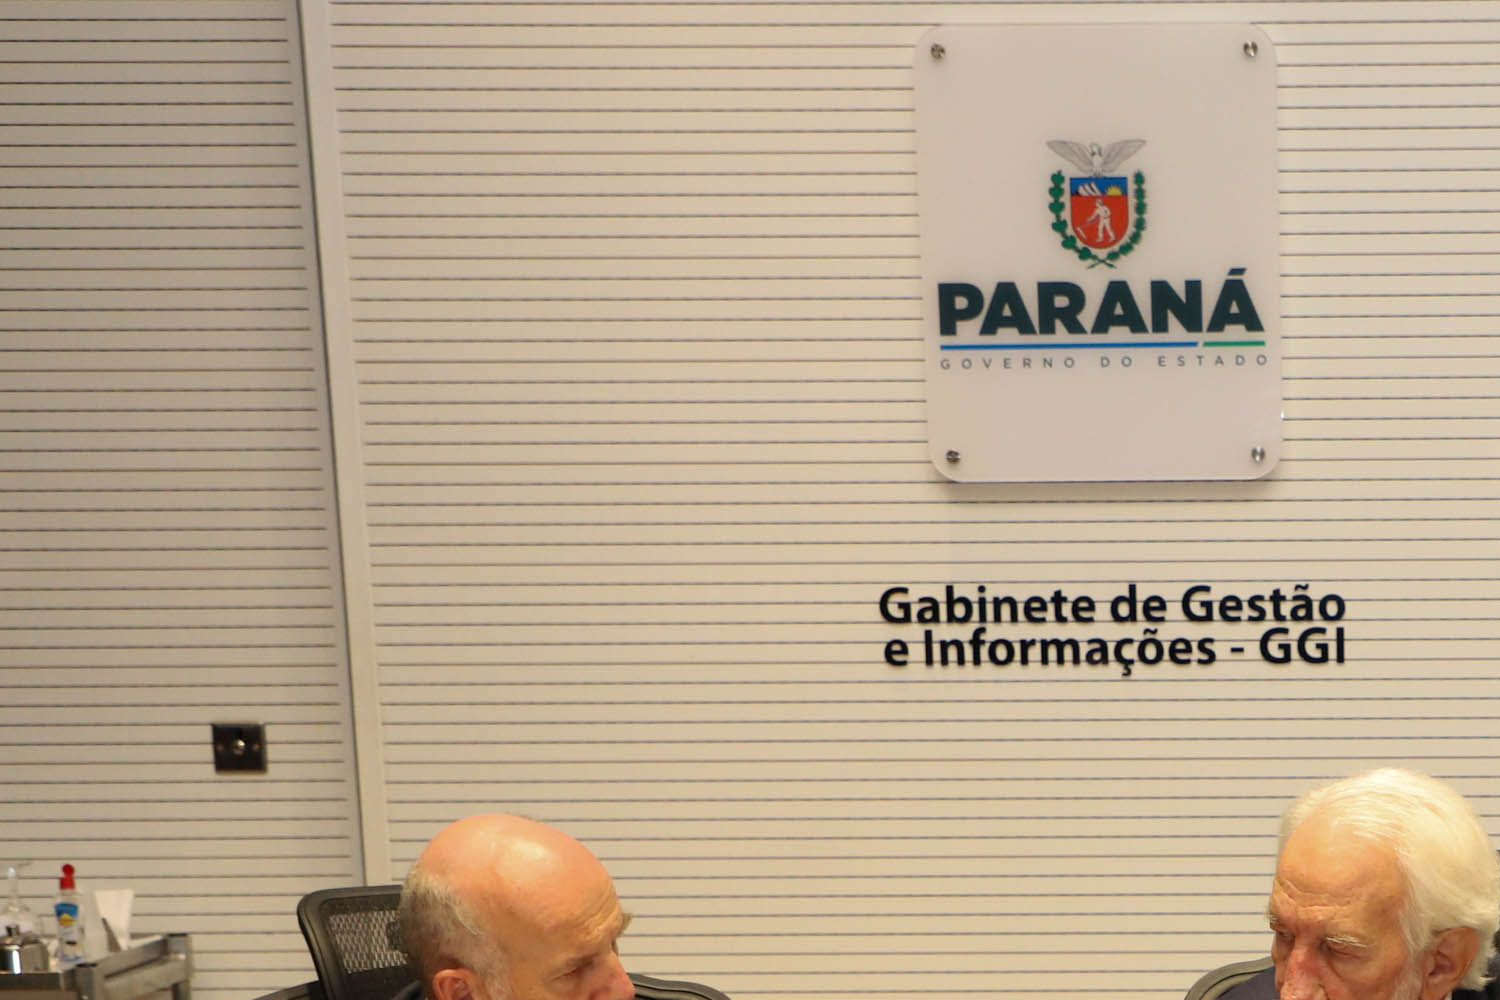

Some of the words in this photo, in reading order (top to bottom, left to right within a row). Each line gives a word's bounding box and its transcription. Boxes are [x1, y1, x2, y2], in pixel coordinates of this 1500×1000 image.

[938, 267, 1265, 336] PARANÁ
[941, 356, 1075, 370] GOVERNO
[1100, 355, 1133, 368] DO
[1158, 354, 1268, 368] ESTADO
[879, 585, 1096, 624] Gabinete
[1109, 584, 1168, 623] de
[1181, 583, 1347, 623] Gestão
[884, 636, 910, 667] e
[924, 628, 1217, 677] Informações
[1259, 626, 1346, 664] GGI
